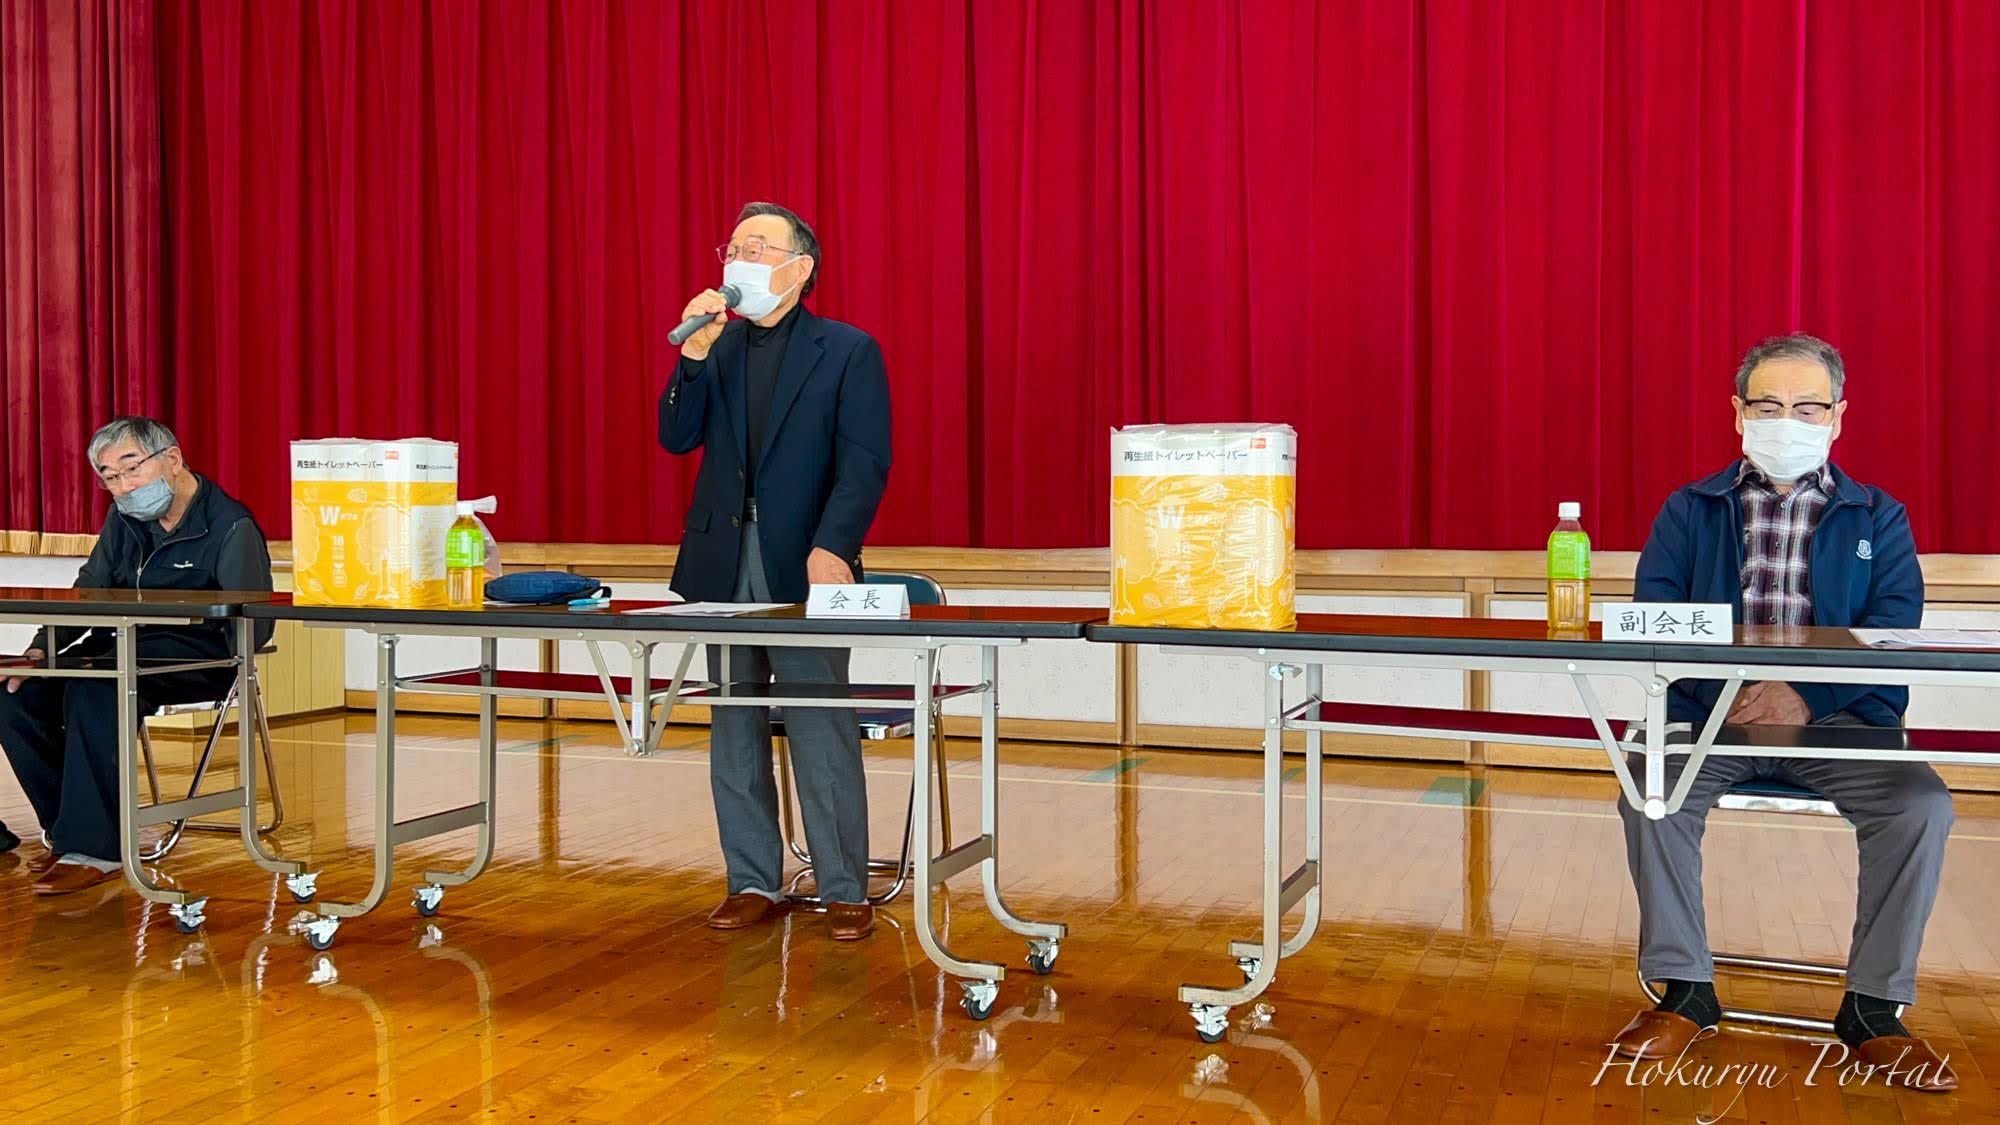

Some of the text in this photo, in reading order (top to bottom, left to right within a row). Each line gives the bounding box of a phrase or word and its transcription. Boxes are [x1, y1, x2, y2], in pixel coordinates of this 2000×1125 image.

[296, 459, 384, 469] 再生紙トイレットペーパー
[1124, 450, 1248, 462] 再生紙トイレットペーパー
[320, 505, 340, 526] W
[828, 589, 881, 610] 会長
[1619, 610, 1715, 636] 副会長
